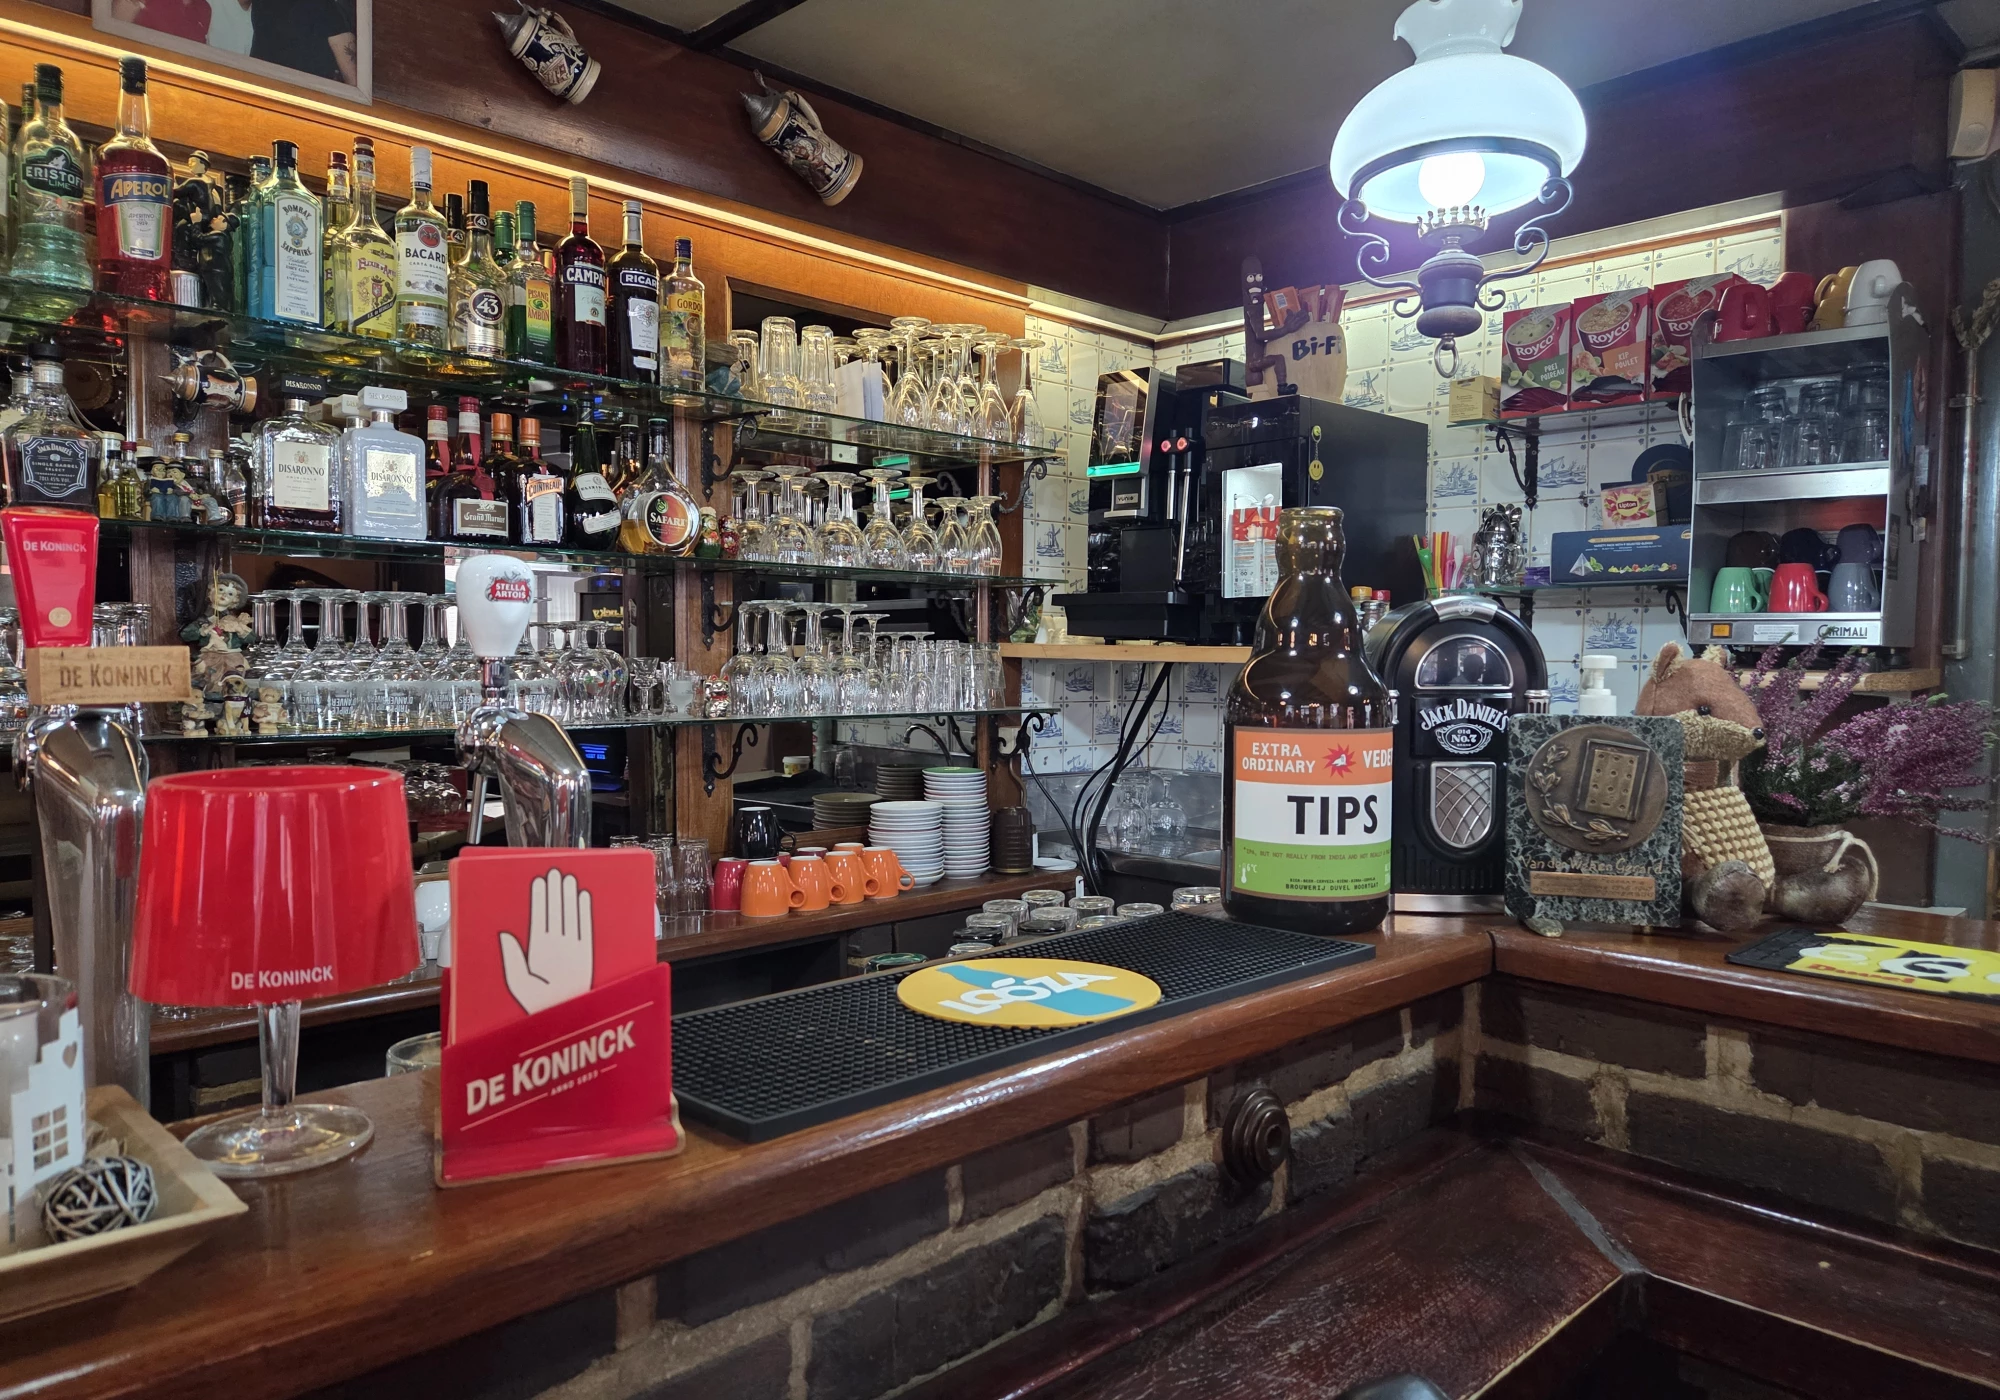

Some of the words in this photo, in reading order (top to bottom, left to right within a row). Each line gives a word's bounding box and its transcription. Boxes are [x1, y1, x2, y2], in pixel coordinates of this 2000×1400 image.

[48, 178, 71, 190] LIME
[110, 178, 169, 199] APEROL
[282, 204, 312, 220] BOMBAY
[476, 215, 488, 226] 43
[280, 240, 314, 257] SAPPHIRE
[405, 247, 446, 265] BACARD
[625, 273, 657, 288] RICAR
[527, 288, 549, 303] PISANG
[476, 296, 499, 315] 43
[527, 306, 550, 322] AMBON
[1668, 318, 1697, 332] Roy
[1292, 335, 1342, 361] Bi-Fi
[1614, 356, 1639, 370] POULET
[1618, 351, 1629, 361] KIP
[1540, 367, 1565, 382] POIREAU
[1544, 362, 1558, 372] PREI
[285, 379, 322, 391] DISARONNO
[278, 463, 325, 477] DISARONNO
[371, 471, 412, 484] DISARONNO
[529, 481, 560, 496] COINTREAU
[1618, 501, 1637, 509] Lipton
[463, 511, 485, 521] Grand
[650, 512, 685, 527] SAFARI
[23, 540, 39, 552] DE
[40, 540, 87, 553] KONINCK
[494, 590, 527, 599] ARTOIS
[495, 582, 526, 592] STELLA
[59, 665, 83, 688] DE
[90, 662, 173, 688] KONINCK
[1419, 703, 1456, 731] JACK
[1456, 698, 1510, 731] DANIEL'S
[1450, 734, 1477, 743] No.7
[1252, 742, 1302, 757] EXTRA
[1242, 756, 1316, 773] ORDINARY
[1286, 794, 1378, 836] TIPS
[1520, 855, 1545, 869] Van
[1615, 857, 1663, 874] Gerard
[1285, 883, 1326, 891] BROUWERIJ
[231, 971, 255, 990] DE
[258, 964, 333, 989] KONINCK
[466, 1072, 506, 1115] DE
[512, 1020, 636, 1097] KONINCK
[550, 1079, 575, 1096] ANNO
